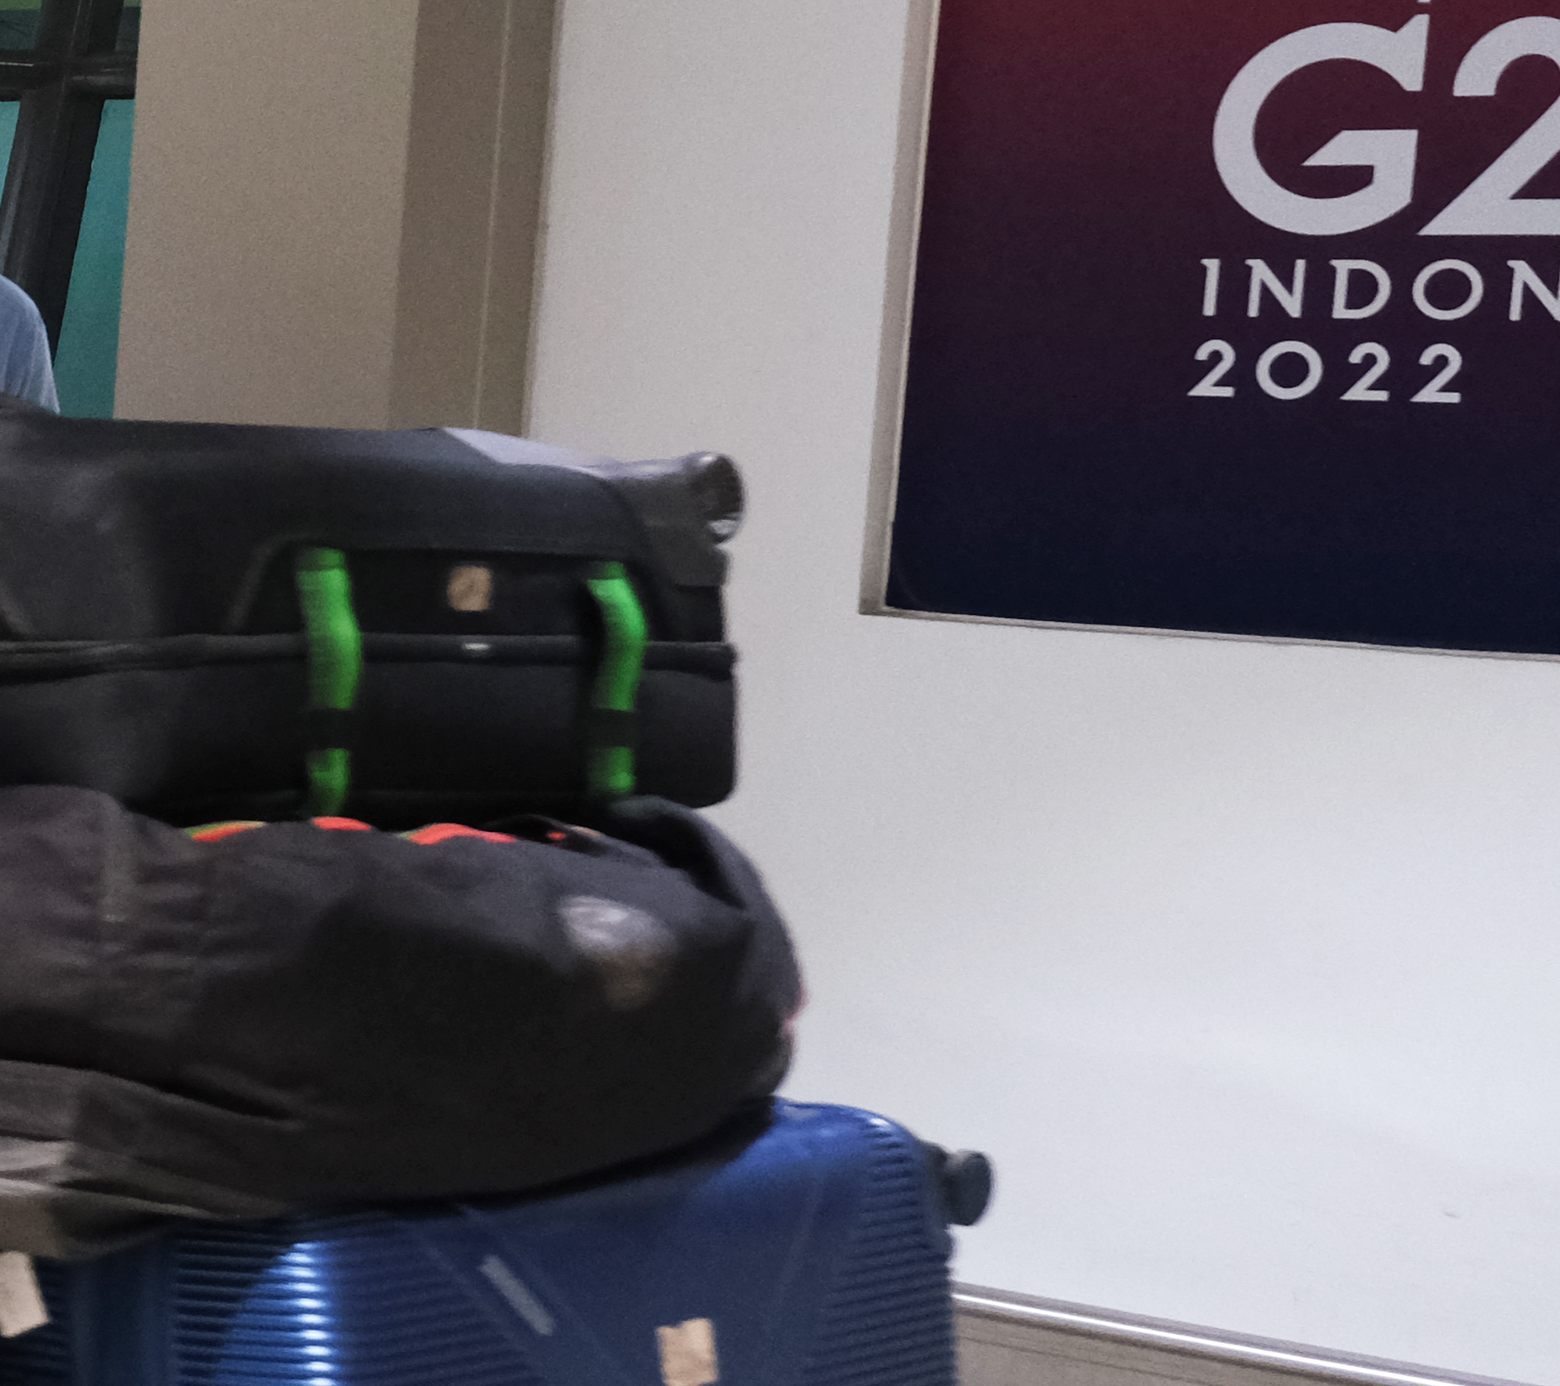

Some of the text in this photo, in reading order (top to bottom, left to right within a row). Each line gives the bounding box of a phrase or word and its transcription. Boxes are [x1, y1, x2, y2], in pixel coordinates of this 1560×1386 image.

[1213, 14, 1560, 236] G2
[1200, 258, 1560, 322] INDON
[1186, 339, 1462, 403] 2022
